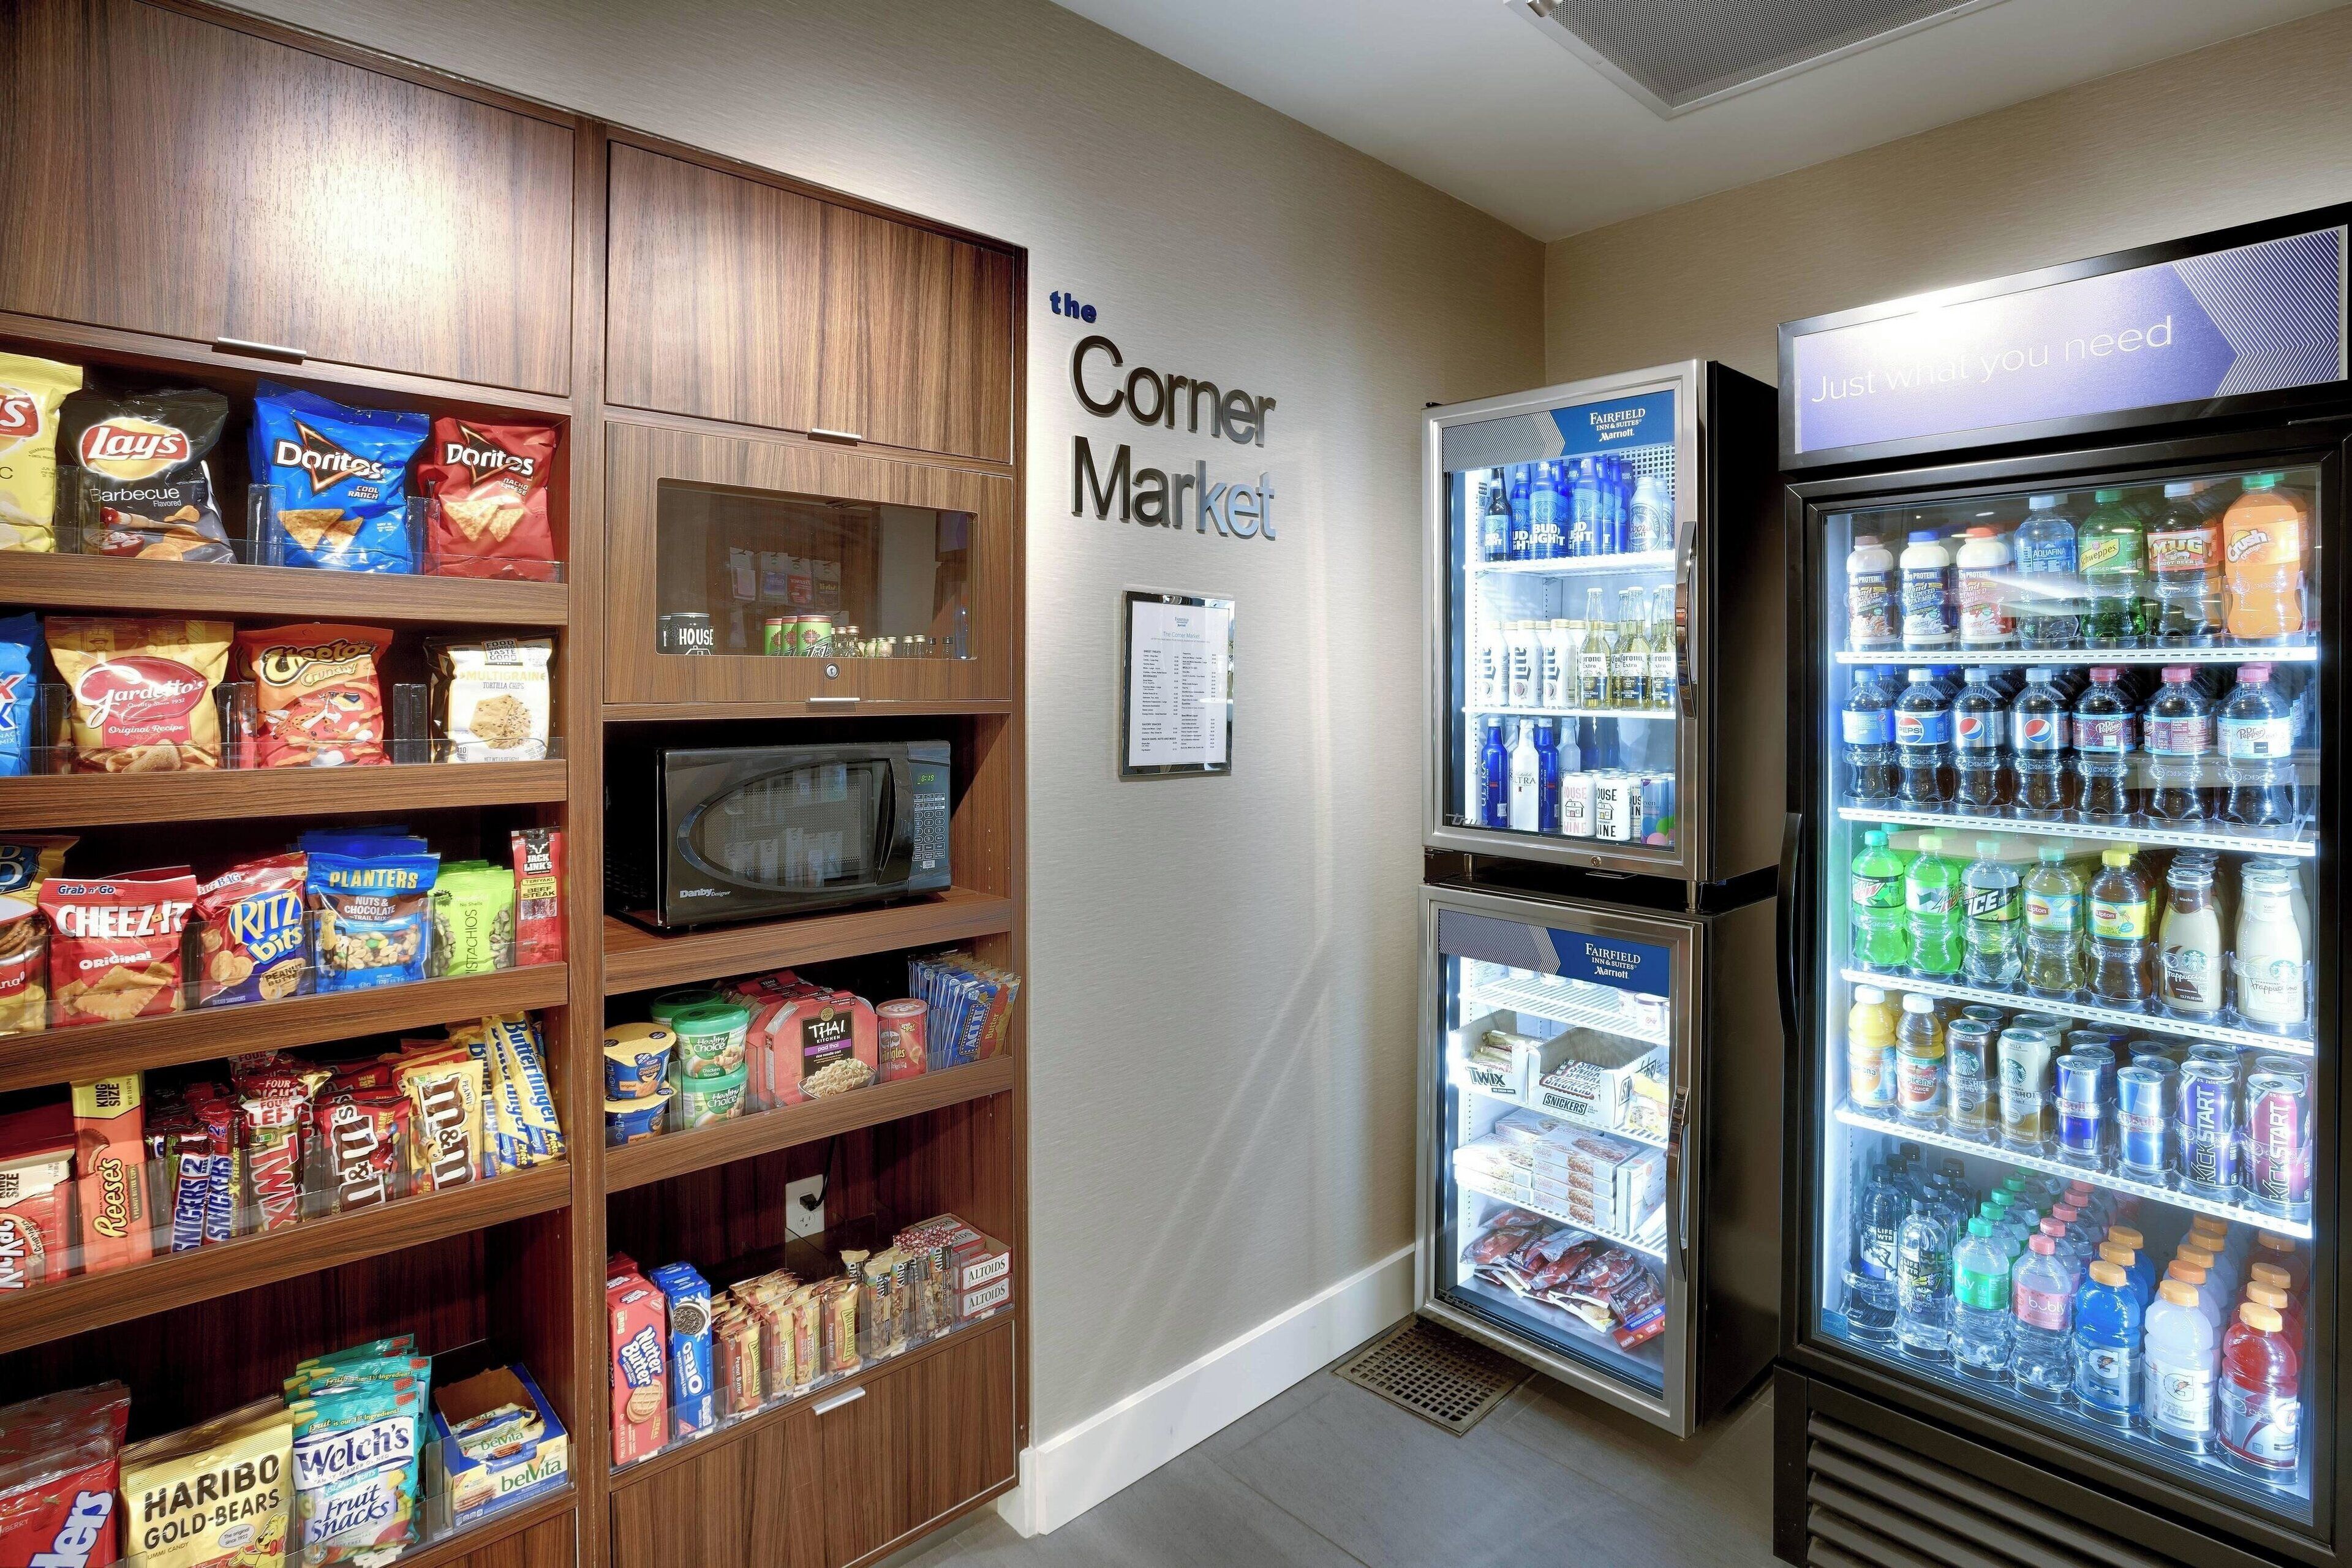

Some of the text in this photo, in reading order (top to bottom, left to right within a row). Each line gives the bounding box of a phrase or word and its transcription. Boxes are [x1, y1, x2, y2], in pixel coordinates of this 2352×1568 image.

[1050, 290, 1097, 323] the
[1812, 314, 2173, 403] Just what you need
[1069, 336, 1276, 447] Corner
[1589, 408, 1646, 425] FAIRFIELD
[88, 426, 183, 461] Lay's
[1599, 428, 1634, 442] Marriott
[275, 439, 385, 480] Doritos
[446, 442, 534, 476] Doritos
[356, 486, 378, 494] COOL
[503, 478, 529, 490] NACHO
[1071, 435, 1276, 540] Market
[89, 488, 180, 502] Barbecue
[348, 491, 378, 500] RANCH
[1532, 523, 1558, 534] BUD
[2034, 547, 2066, 558] AQUAFINA
[2080, 544, 2119, 566] Schweppes
[2152, 539, 2204, 558] MUG
[2226, 528, 2269, 563] Crush
[679, 628, 714, 646] HOUSE
[264, 639, 376, 687] Cheetos
[300, 663, 357, 687] Crunchy
[467, 671, 539, 681] MULTIGRAIN
[108, 725, 150, 736] Original
[152, 724, 185, 734] Recipe
[1898, 726, 1923, 735] PEPSI
[2097, 723, 2122, 733] Pepper
[2237, 723, 2265, 740] Pepper
[524, 861, 553, 872] LINK'S
[527, 854, 549, 863] JACK
[58, 885, 115, 894] Grab Go
[217, 872, 240, 888] BAG
[330, 870, 419, 889] PLANTERS
[355, 897, 380, 906] NUTS
[679, 888, 714, 899] Danby
[1967, 891, 1999, 915] ICE
[231, 891, 298, 944] RITZ
[344, 905, 396, 916] CHOCOLATE
[2028, 905, 2047, 914] Lipton
[249, 927, 303, 962] bits
[1585, 943, 1641, 964] FAIRFIELD
[265, 963, 303, 981] PEANUT
[1592, 957, 1635, 970] INN SUITES
[1594, 966, 1629, 980] Marriott
[809, 1020, 845, 1038] THAI
[985, 1014, 999, 1039] Butter
[693, 1042, 726, 1053] Choice
[697, 1035, 728, 1046] Healthy
[816, 1035, 840, 1044] KITCHEN
[818, 1044, 829, 1052] pad
[502, 1020, 556, 1124] Butterfinger
[266, 1080, 292, 1088] FOUR
[463, 1080, 474, 1106] PEANUT
[712, 1088, 739, 1100] Healthy
[1545, 1076, 1596, 1096] SNICKERS
[96, 1084, 108, 1107] KING
[108, 1083, 121, 1107] SIZE
[707, 1095, 737, 1108] Choice
[1545, 1094, 1585, 1114] SNICKERS
[249, 1104, 303, 1126] LEFT
[183, 1158, 202, 1174] 2
[250, 1133, 298, 1229] TWIX
[93, 1158, 128, 1238] Reese's
[206, 1156, 233, 1241] SNICKERS
[172, 1178, 209, 1253] SNICKERS
[934, 1247, 943, 1272] KIND
[1903, 1260, 1919, 1269] LIFE
[897, 1264, 905, 1287] KIND
[968, 1258, 1006, 1282] ALTOIDS
[876, 1275, 886, 1299] KIND
[968, 1284, 1006, 1310] ALTOIDS
[2028, 1297, 2066, 1315] bubly
[636, 1325, 662, 1374] Nutter
[621, 1340, 651, 1386] Butter
[682, 1341, 703, 1394] OREO
[309, 1419, 331, 1433] Fruit
[481, 1431, 524, 1451] belVita
[295, 1425, 409, 1481] Welch's
[501, 1456, 562, 1492] belVita
[144, 1454, 280, 1523] HARIBO
[325, 1483, 381, 1521] Fruit
[144, 1488, 280, 1550] GOLD-BEARS
[168, 1541, 189, 1553] CANDY
